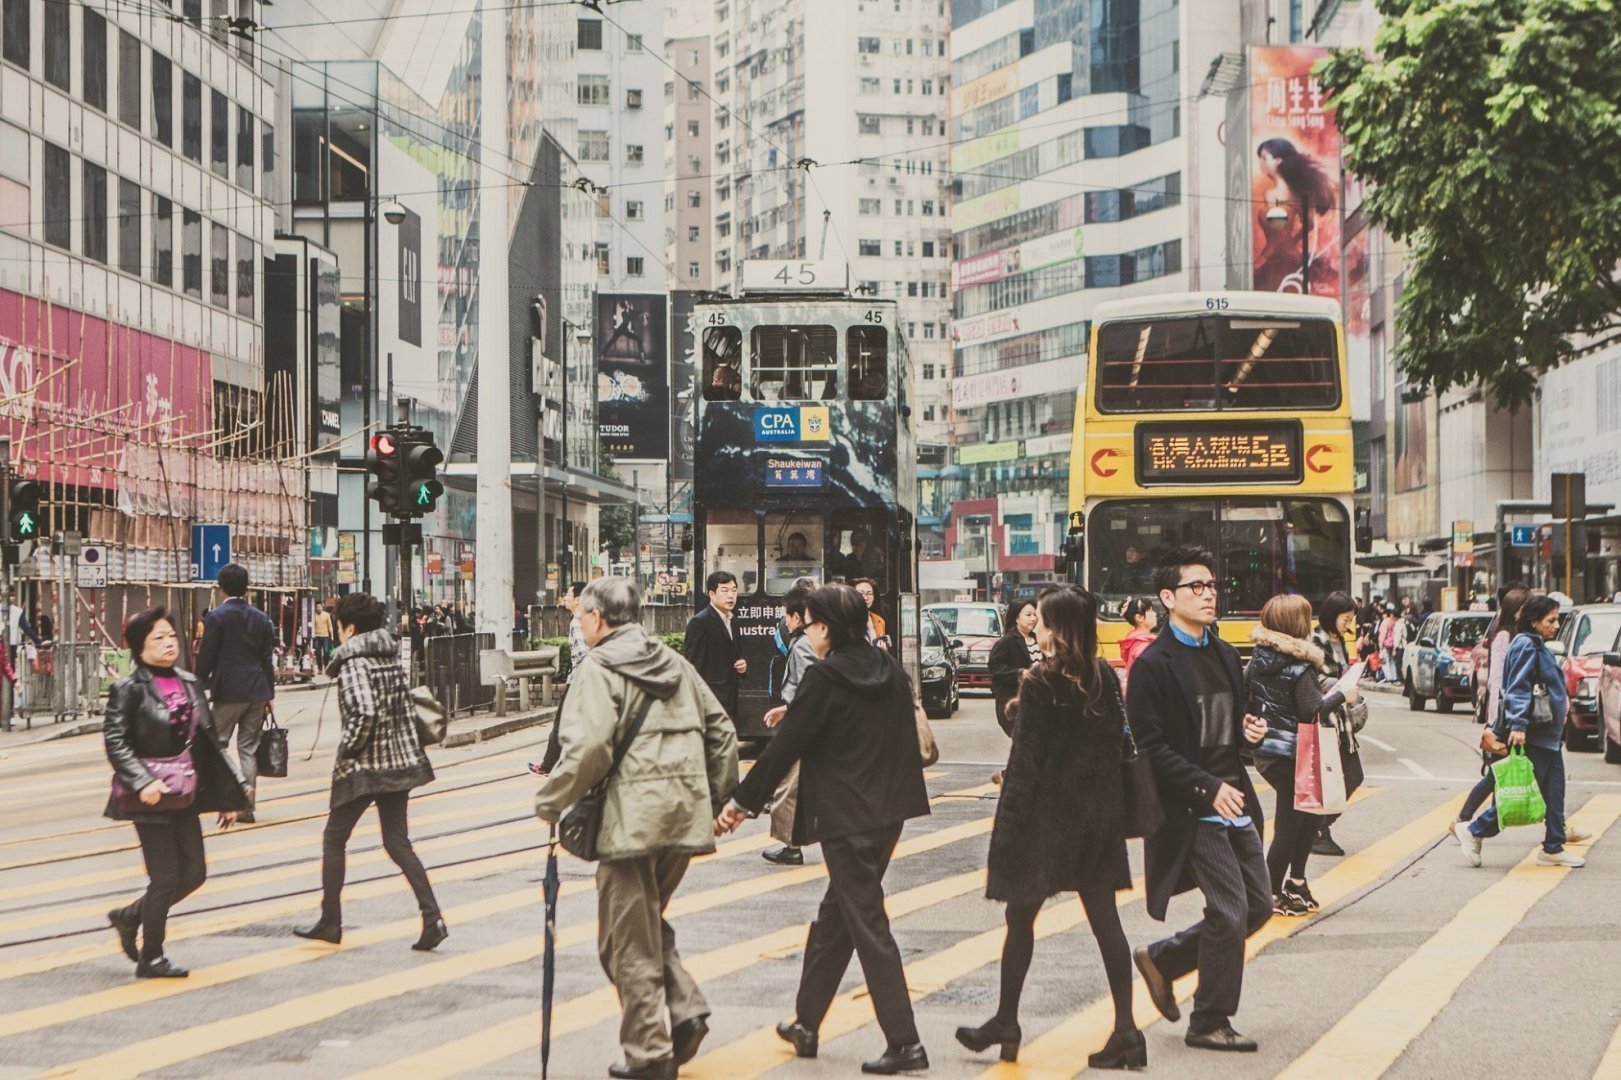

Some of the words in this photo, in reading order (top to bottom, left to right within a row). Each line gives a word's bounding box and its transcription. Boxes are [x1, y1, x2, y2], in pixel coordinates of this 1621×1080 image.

[403, 246, 417, 304] GAP
[773, 263, 817, 285] 45
[1206, 297, 1229, 310] 615
[708, 312, 726, 325] 45
[864, 310, 883, 324] 45
[321, 409, 341, 430] CHANEL
[760, 413, 795, 429] CPA
[599, 424, 630, 433] TUDOR
[1250, 435, 1291, 468] 5B
[768, 458, 823, 469] Shaukeiwan
[1153, 456, 1177, 469] HK
[1184, 455, 1247, 469] Stadium
[737, 605, 787, 620] 立即申請
